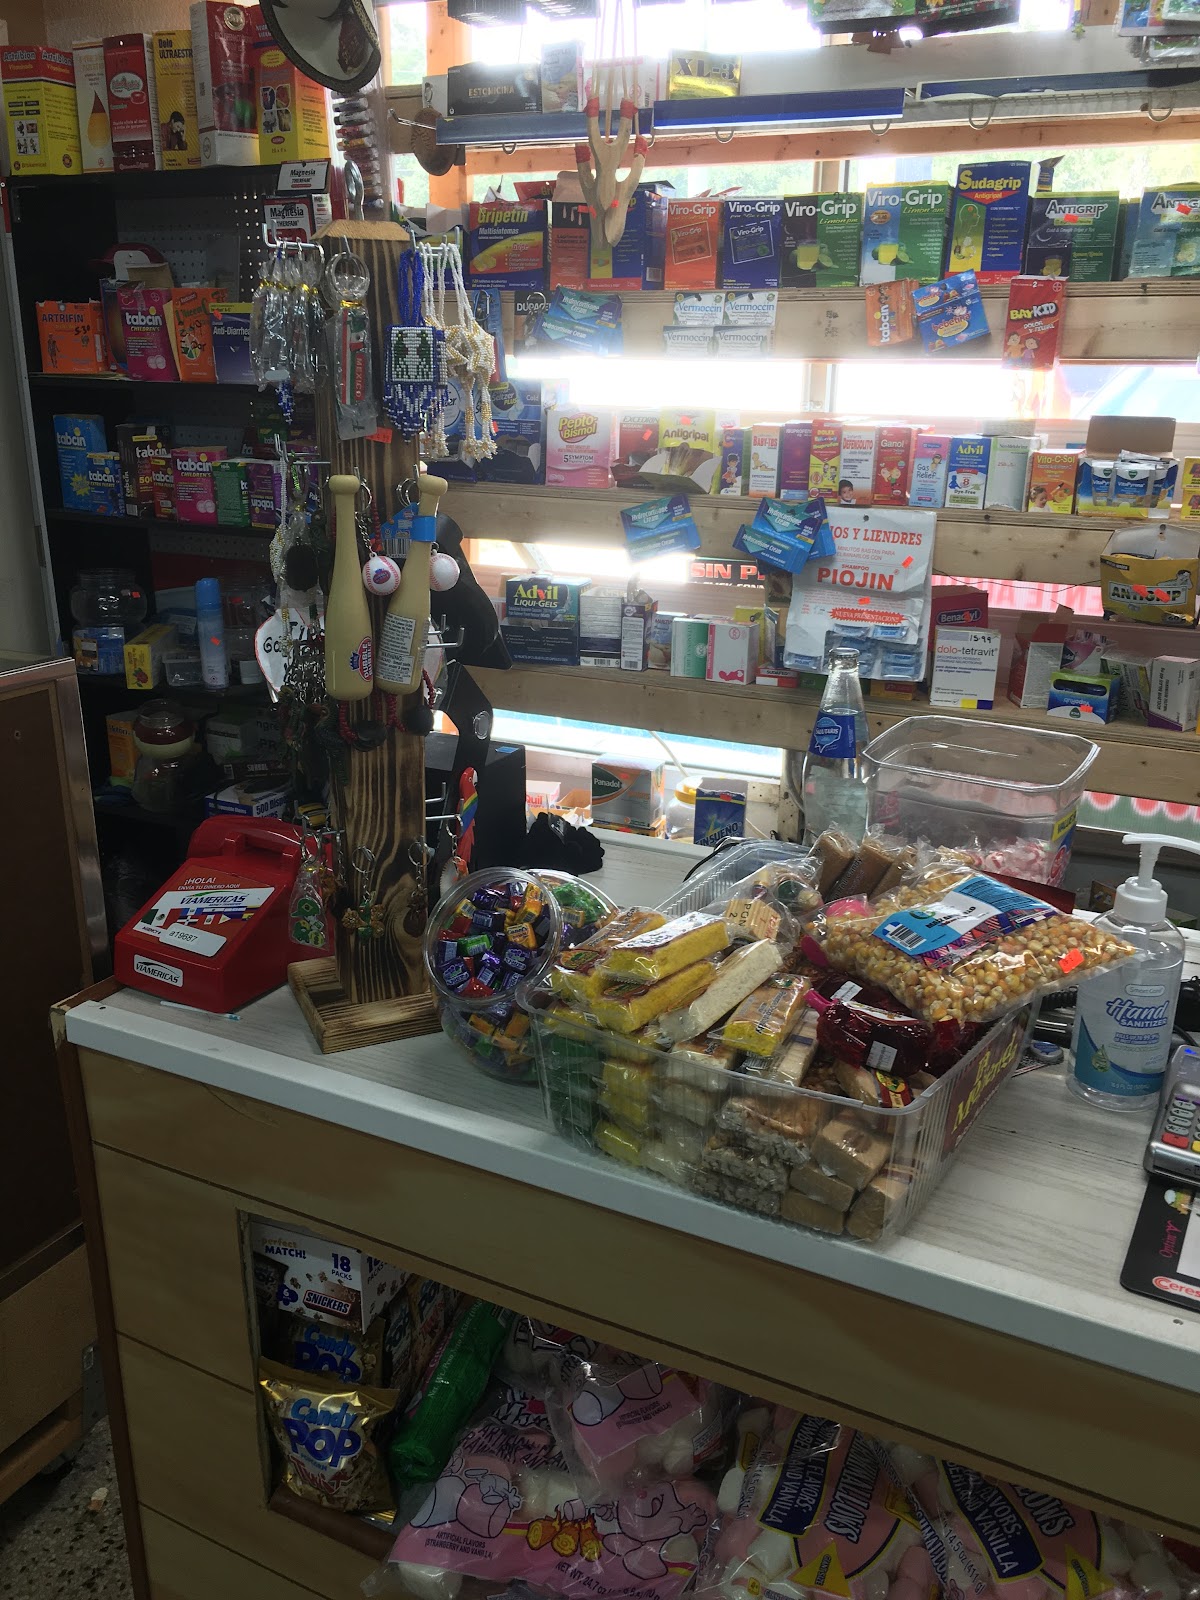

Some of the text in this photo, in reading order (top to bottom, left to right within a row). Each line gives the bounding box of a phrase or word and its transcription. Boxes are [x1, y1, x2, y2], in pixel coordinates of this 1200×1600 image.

[290, 168, 316, 177] Magnesia
[958, 169, 1022, 191] Sudagrip
[866, 188, 943, 209] Viro-Grip
[669, 203, 717, 218] Viro-Grip
[728, 201, 781, 216] Viro-Grip
[784, 200, 857, 218] Viro-Grip
[1046, 200, 1105, 218] ANTIGRIP
[477, 207, 529, 226] Gripetin
[737, 226, 764, 236] Viro-Grip
[42, 312, 84, 323] ARTRIFIN
[570, 305, 587, 315] Cream
[1009, 302, 1059, 320] BAYKID
[125, 310, 163, 328] tabcin
[880, 304, 890, 343] tabcin
[1023, 320, 1043, 330] DOLOR
[355, 357, 366, 398] MEXICO
[558, 414, 598, 432] Pepto-
[56, 431, 87, 447] tabcin
[563, 425, 597, 440] Bismol
[663, 428, 709, 442] Antigripal
[136, 445, 168, 458] tabcin
[956, 444, 983, 455] Advil
[175, 458, 212, 473] tabcin
[563, 454, 569, 463] 5
[1036, 454, 1075, 464] Vita-C-Sol
[917, 463, 930, 472] Gas
[88, 469, 116, 483] tabcin
[916, 471, 937, 480] Relief
[962, 478, 970, 486] 8
[643, 514, 660, 524] Cream
[775, 517, 790, 527] Cream
[853, 528, 923, 546] Y LIENDRES
[692, 563, 732, 578] SIN
[841, 563, 870, 571] SHAMPOO
[817, 567, 894, 591] PIOJIN
[513, 584, 560, 600] Adil
[514, 599, 558, 608] LIQUI-GELS
[834, 610, 853, 618] NUEVA
[937, 645, 995, 657] dolo-tetravit
[363, 643, 371, 678] DUBBLE
[593, 777, 621, 789] Panadol
[525, 794, 543, 806] Quil
[256, 802, 269, 815] 500
[184, 877, 216, 886] ¡HOLA!
[180, 895, 247, 905] VIAMERICAS
[136, 963, 179, 984] VIAMERICAS
[1107, 998, 1169, 1020] Hand
[1120, 1018, 1168, 1028] SANITIZER
[265, 1245, 307, 1260] MATCH!
[331, 1253, 351, 1273] 18
[331, 1269, 353, 1281] PACKS
[283, 1288, 289, 1297] 6
[305, 1291, 350, 1314] SNICKERS
[304, 1324, 356, 1358] Candy
[290, 1398, 357, 1429] Candy
[283, 1417, 363, 1468] POP
[765, 1483, 793, 1524] VANILLA
[435, 1531, 486, 1548] ARTIFICIAL FLAVORS
[945, 1529, 961, 1552] 14.5
[974, 1512, 1020, 1574] VANILLA
[459, 1545, 471, 1554] AND
[555, 1562, 571, 1575] NET
